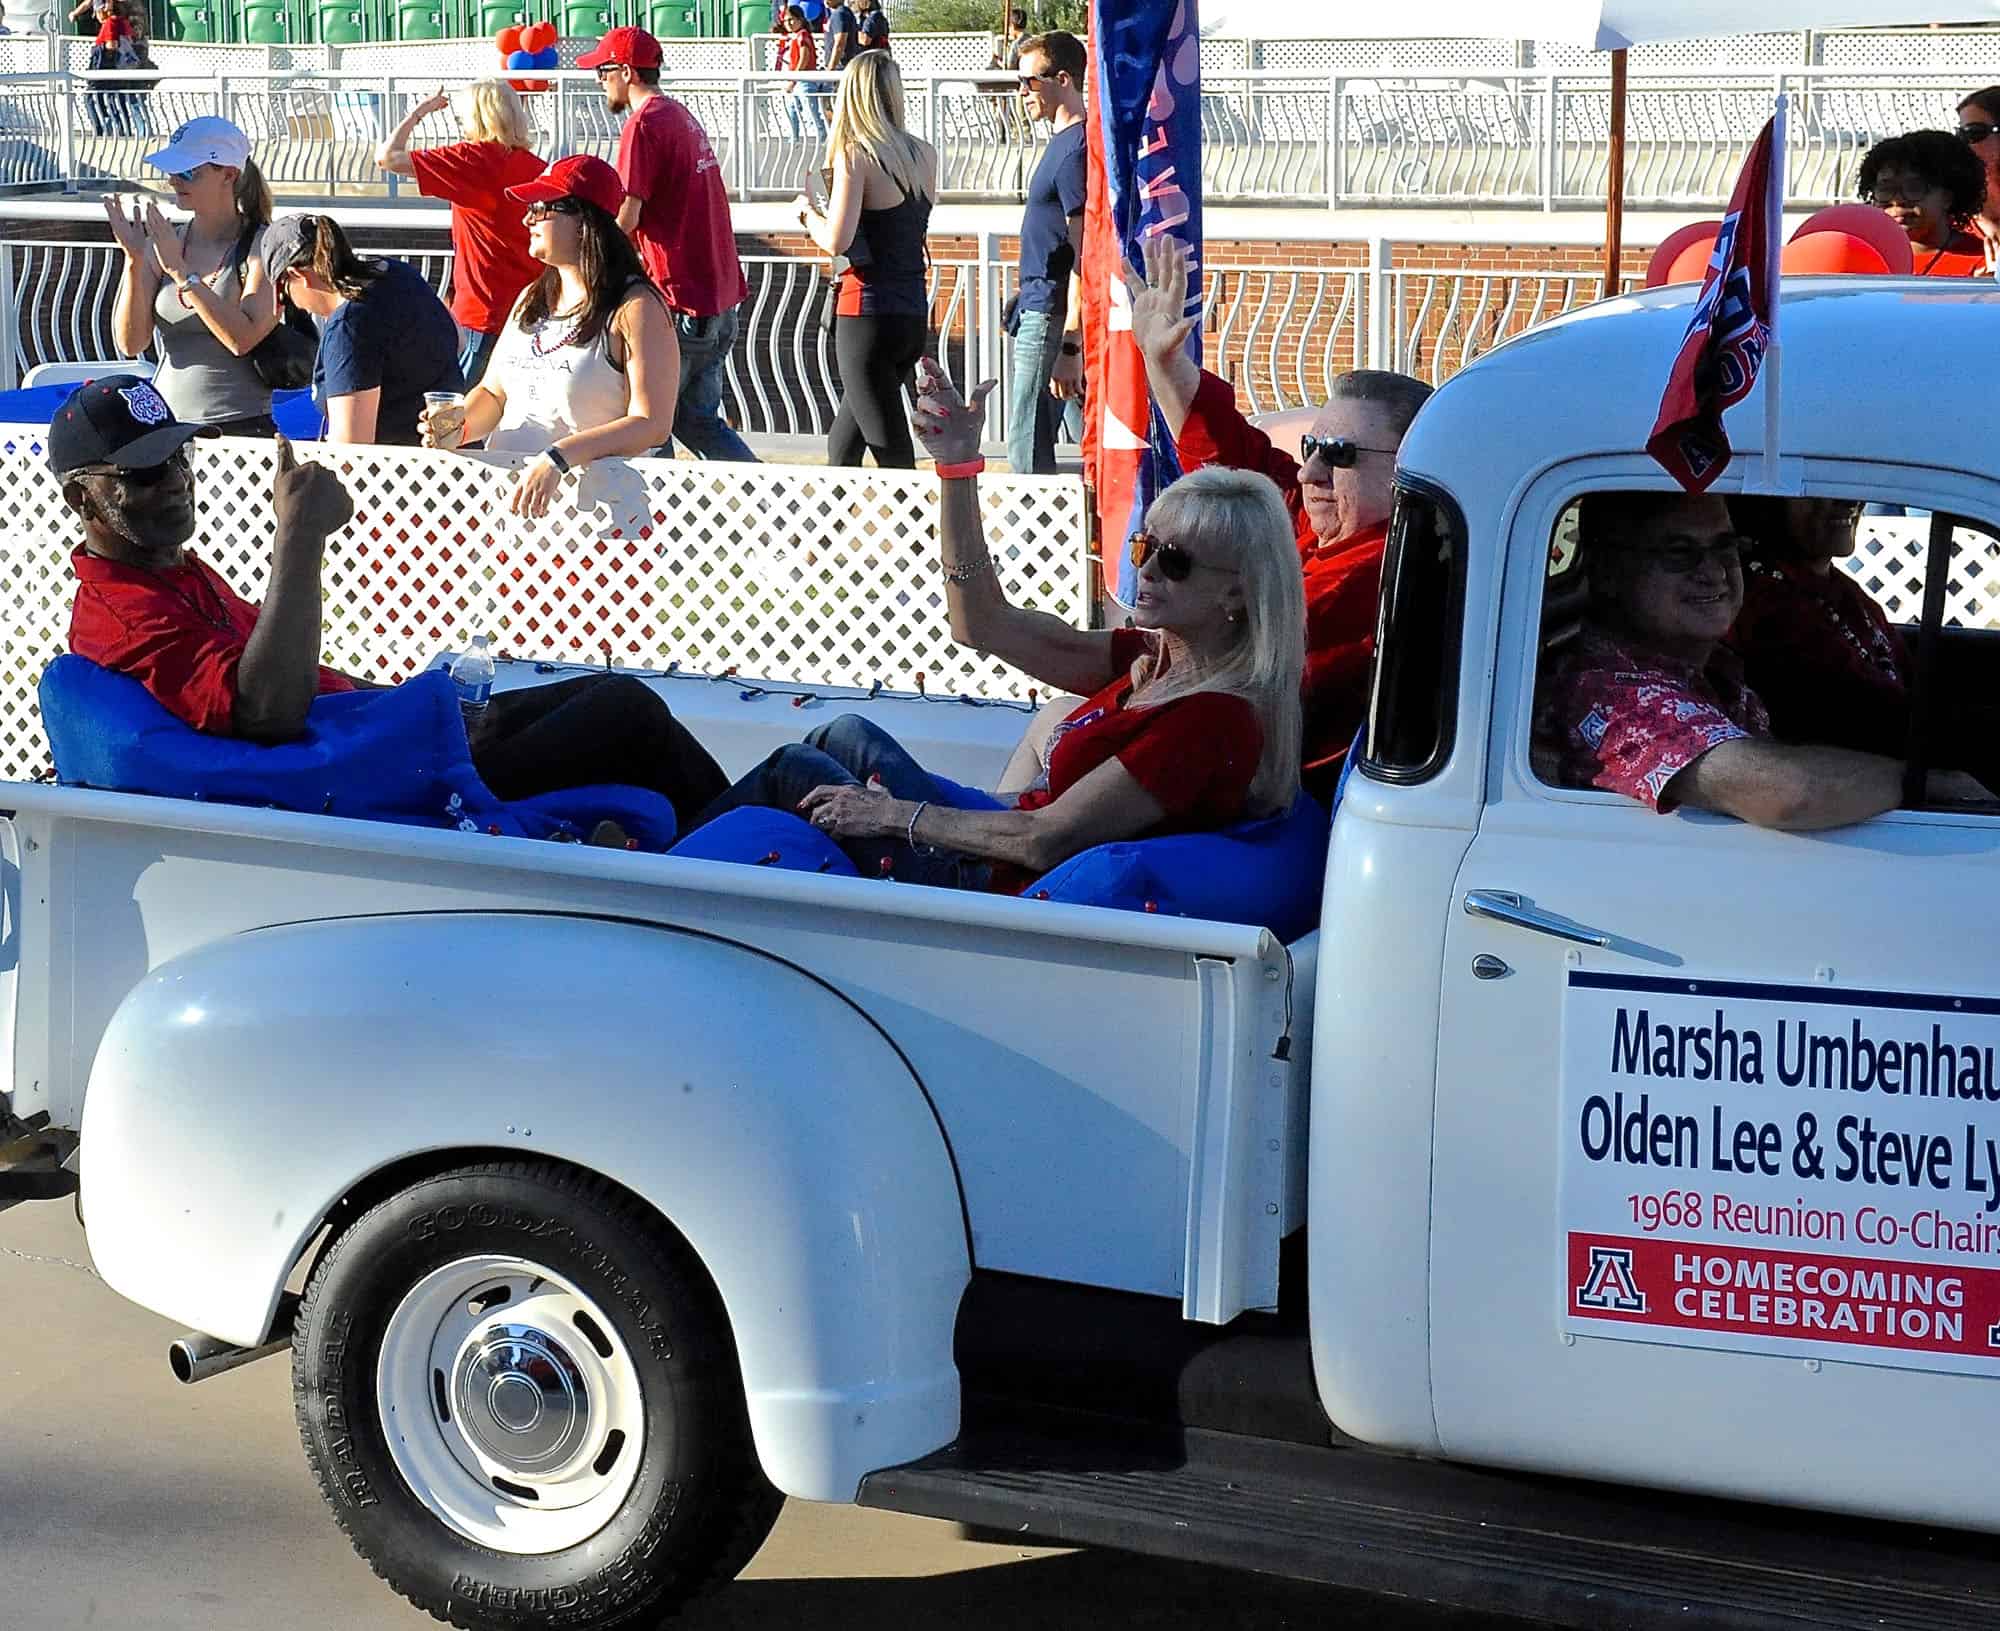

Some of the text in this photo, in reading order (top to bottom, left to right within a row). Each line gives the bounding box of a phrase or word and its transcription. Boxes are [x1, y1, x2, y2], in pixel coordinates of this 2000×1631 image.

[1611, 1007, 1764, 1085] Marsha
[1580, 1091, 1698, 1169] Olden
[1711, 1105, 1782, 1176] Lee
[1792, 1111, 1825, 1180] &
[1835, 1114, 1953, 1190] Steve
[1628, 1190, 1702, 1232] 1968
[1712, 1194, 1846, 1242] Reunion
[1673, 1253, 1965, 1307] HOMECOMING
[1674, 1288, 1964, 1342] CELEBRATION
